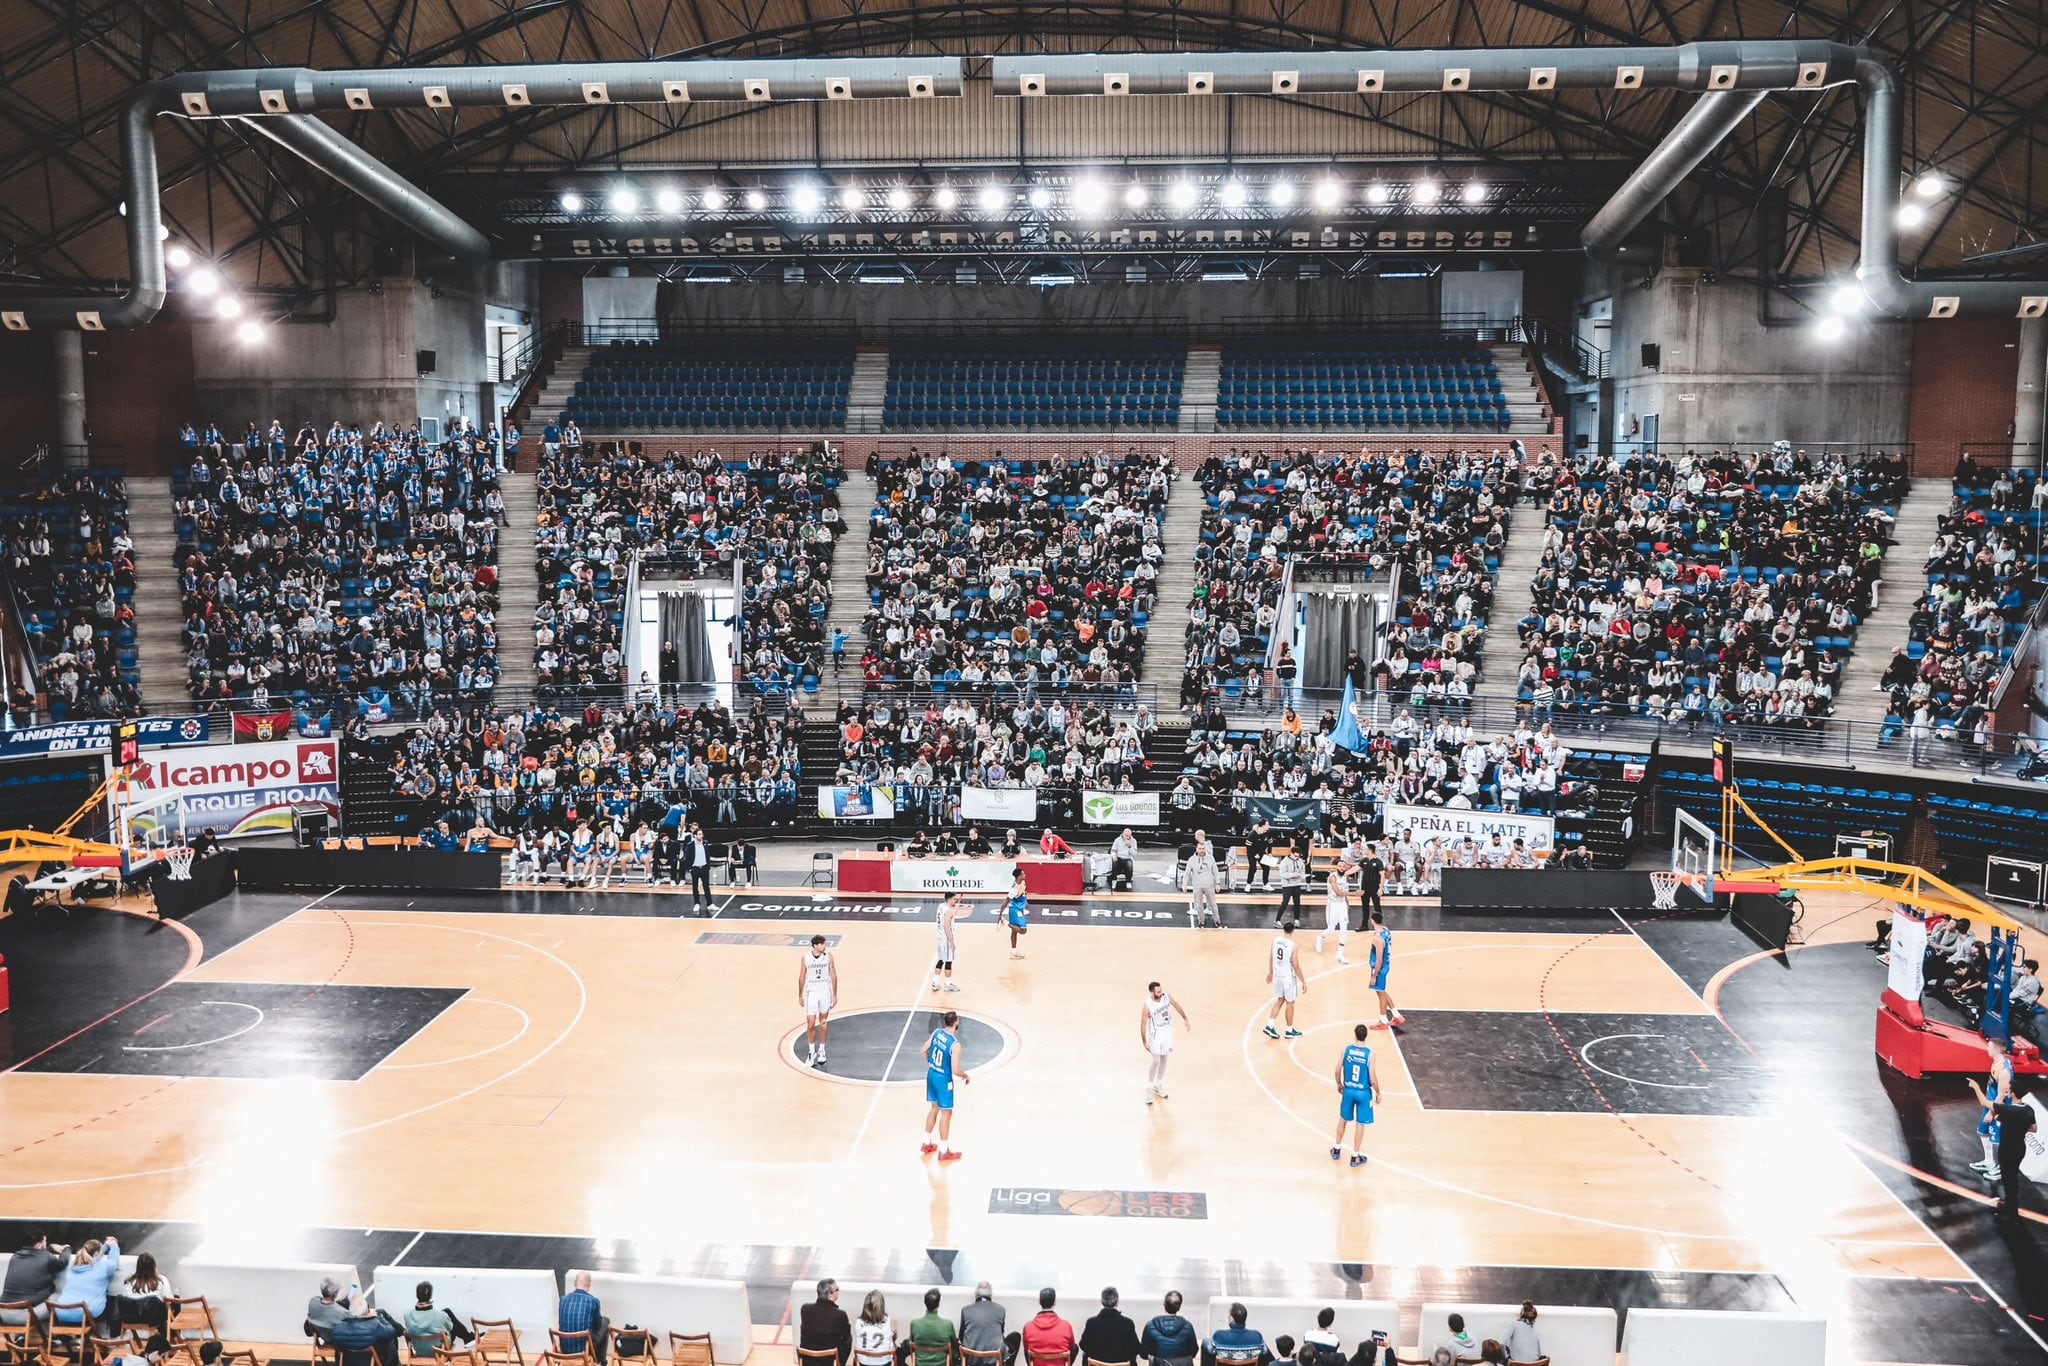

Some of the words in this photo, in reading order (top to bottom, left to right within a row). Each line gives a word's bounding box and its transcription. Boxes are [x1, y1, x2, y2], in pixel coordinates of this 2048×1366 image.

[9, 724, 89, 743] ANDRÉS
[49, 738, 77, 750] ON
[161, 792, 256, 816] PARQUE
[264, 786, 333, 805] RIOJA
[1410, 814, 1452, 831] PEÑA
[1456, 820, 1475, 834] EL
[1481, 823, 1527, 838] MATE
[923, 879, 984, 888] RIOVERDE
[740, 903, 922, 915] Comunidad
[1041, 908, 1079, 917] La
[1091, 909, 1172, 920] Rioja
[1276, 947, 1284, 961] 9
[1352, 1064, 1361, 1082] 9
[996, 1189, 1051, 1205] Liga
[1127, 1193, 1194, 1206] LEB
[1126, 1206, 1191, 1217] ORO
[860, 1332, 884, 1348] 12
